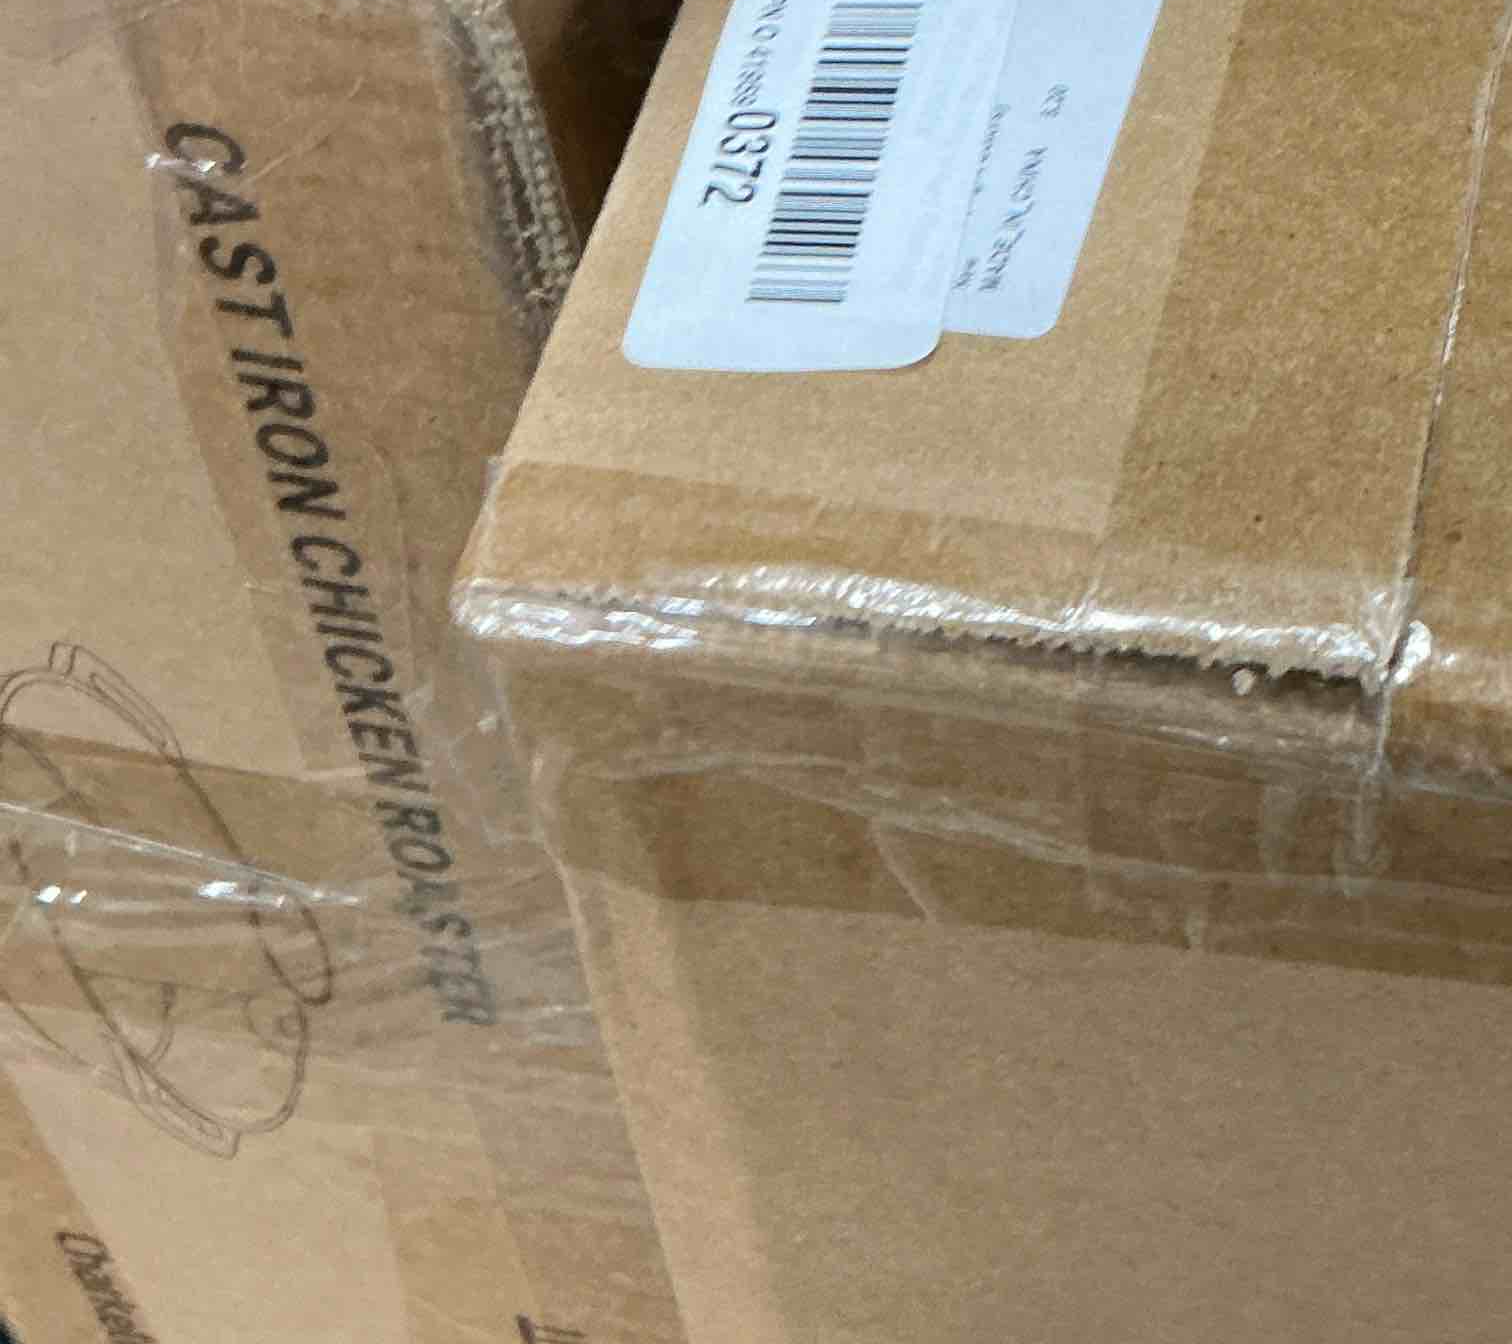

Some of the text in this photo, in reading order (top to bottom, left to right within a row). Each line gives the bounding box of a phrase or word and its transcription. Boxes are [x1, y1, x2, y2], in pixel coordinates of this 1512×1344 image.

[163, 120, 293, 346] CAST
[229, 340, 351, 523] IRON
[289, 532, 429, 796] CHICKEN
